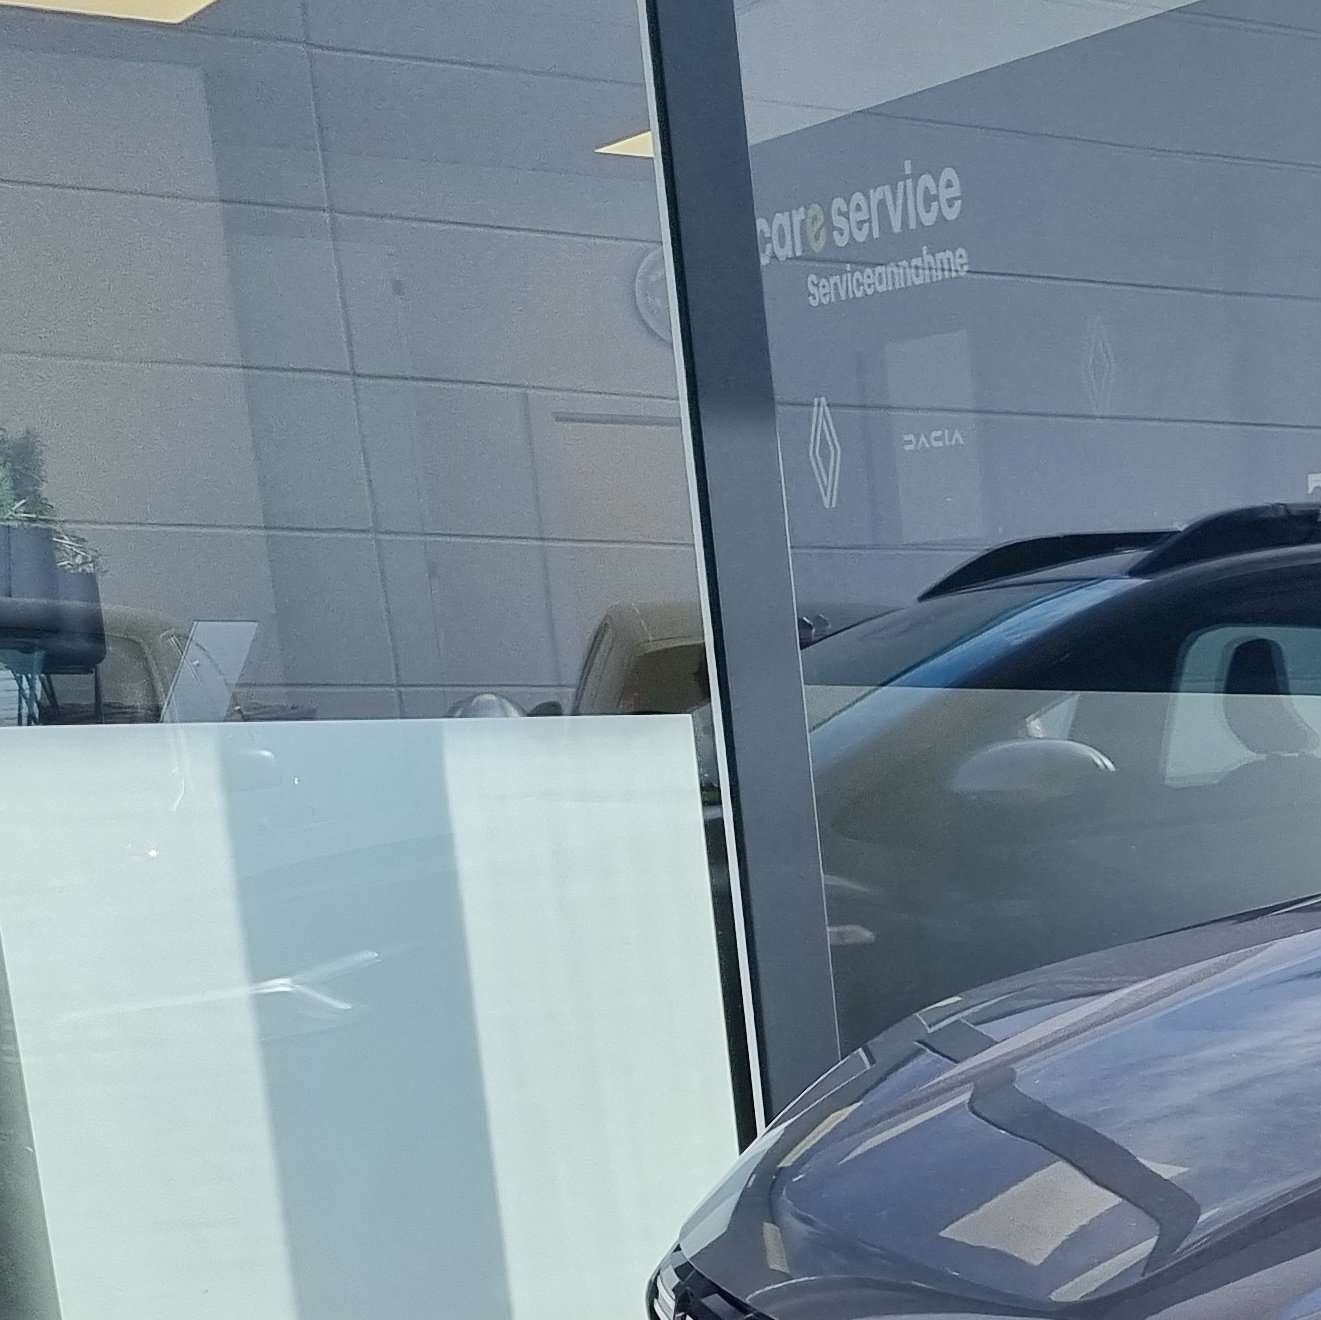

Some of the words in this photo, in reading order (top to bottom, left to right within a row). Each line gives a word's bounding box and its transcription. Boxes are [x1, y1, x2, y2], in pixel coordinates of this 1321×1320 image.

[756, 203, 826, 268] care
[831, 159, 962, 248] service
[807, 245, 970, 308] Serviceannahme
[903, 429, 965, 450] DACIA
